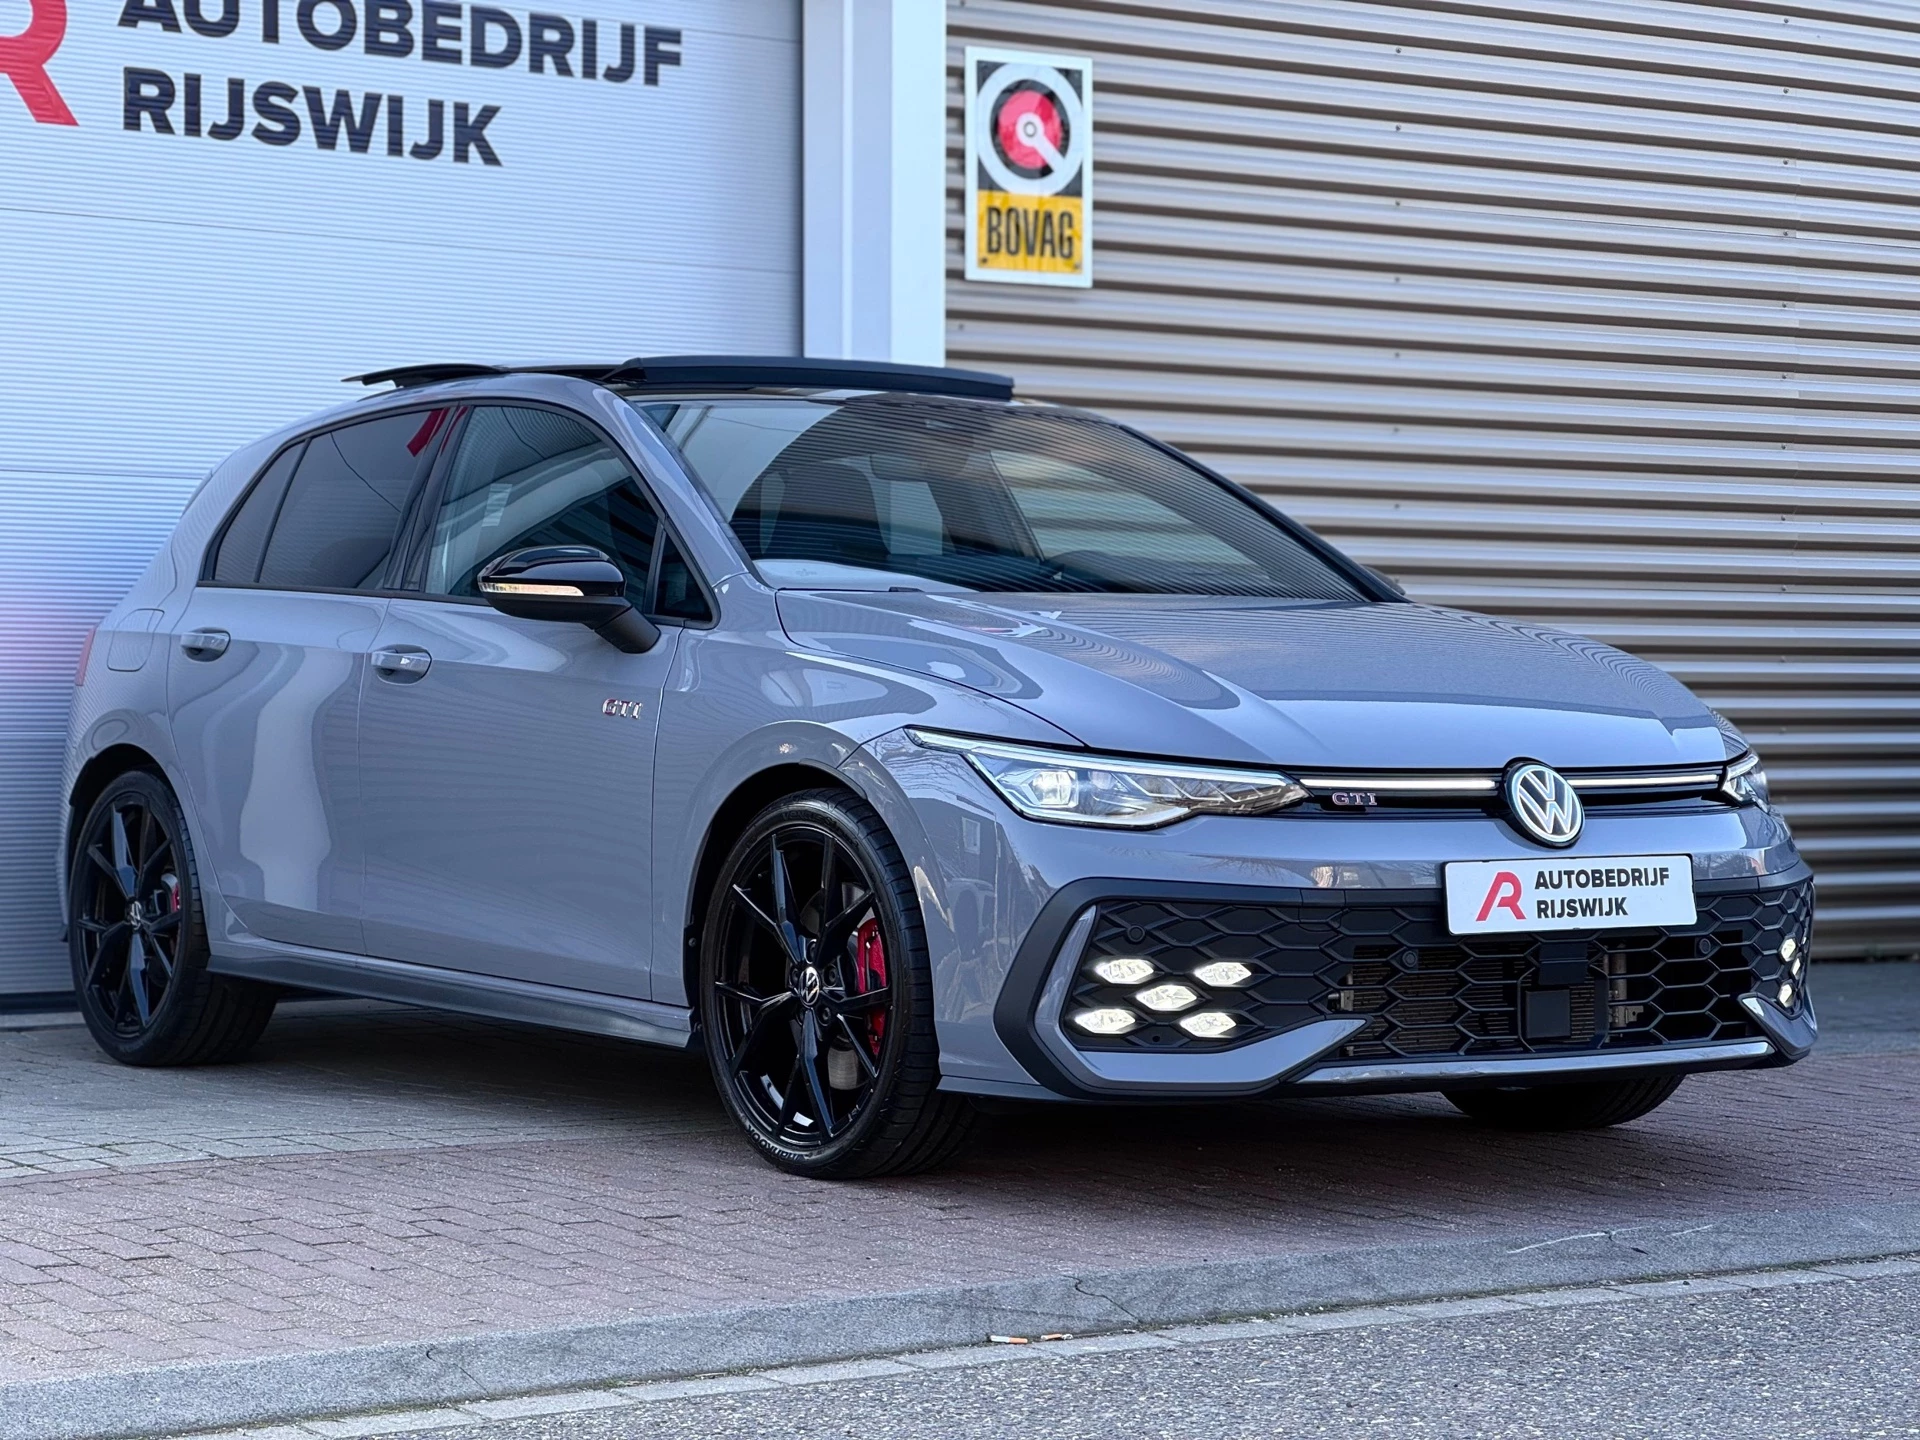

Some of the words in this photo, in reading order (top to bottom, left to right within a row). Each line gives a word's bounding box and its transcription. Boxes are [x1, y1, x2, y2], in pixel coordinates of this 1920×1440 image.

[123, 66, 503, 167] RIJSWIJK
[987, 206, 1073, 259] BOVAG
[602, 698, 642, 719] GTI
[1331, 792, 1378, 806] GTI
[1534, 867, 1670, 890] AUTOBEDRIJF
[1536, 897, 1629, 919] RIJSWIJK
